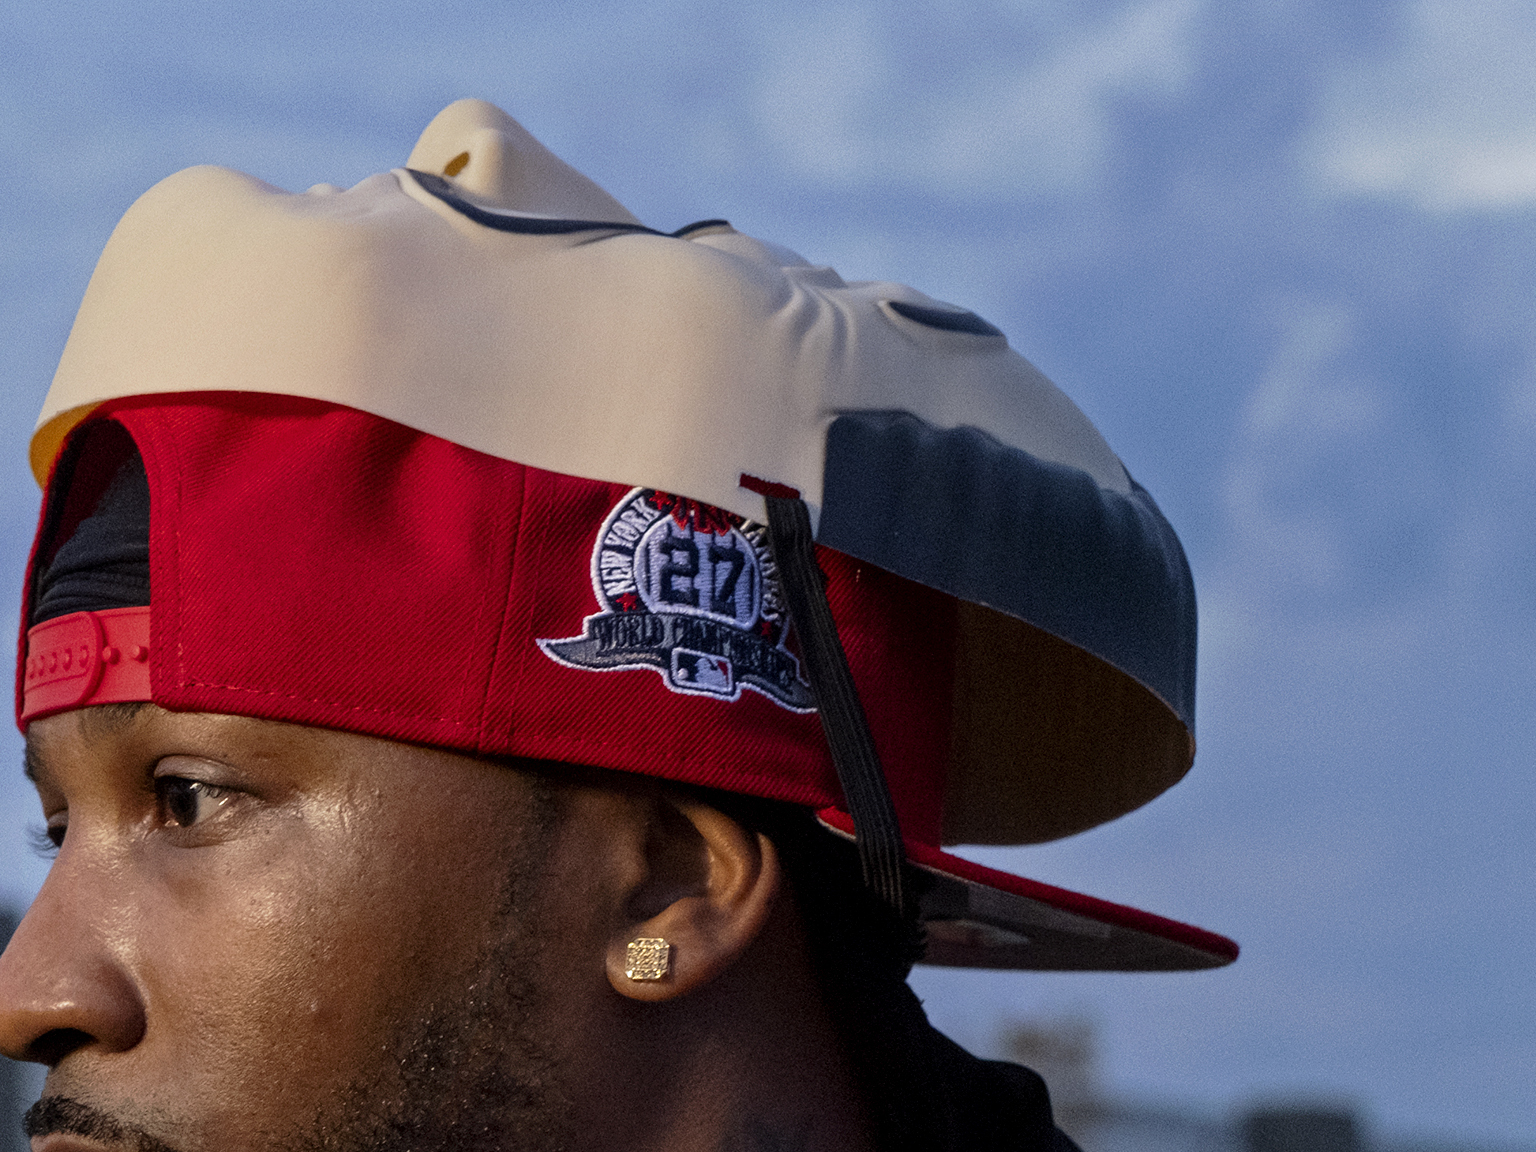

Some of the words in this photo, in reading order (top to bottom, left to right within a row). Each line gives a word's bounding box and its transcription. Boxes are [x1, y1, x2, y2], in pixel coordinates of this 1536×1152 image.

[604, 495, 662, 549] YORK
[600, 550, 636, 596] NEW
[658, 535, 746, 619] 27
[587, 612, 665, 655] WORLD
